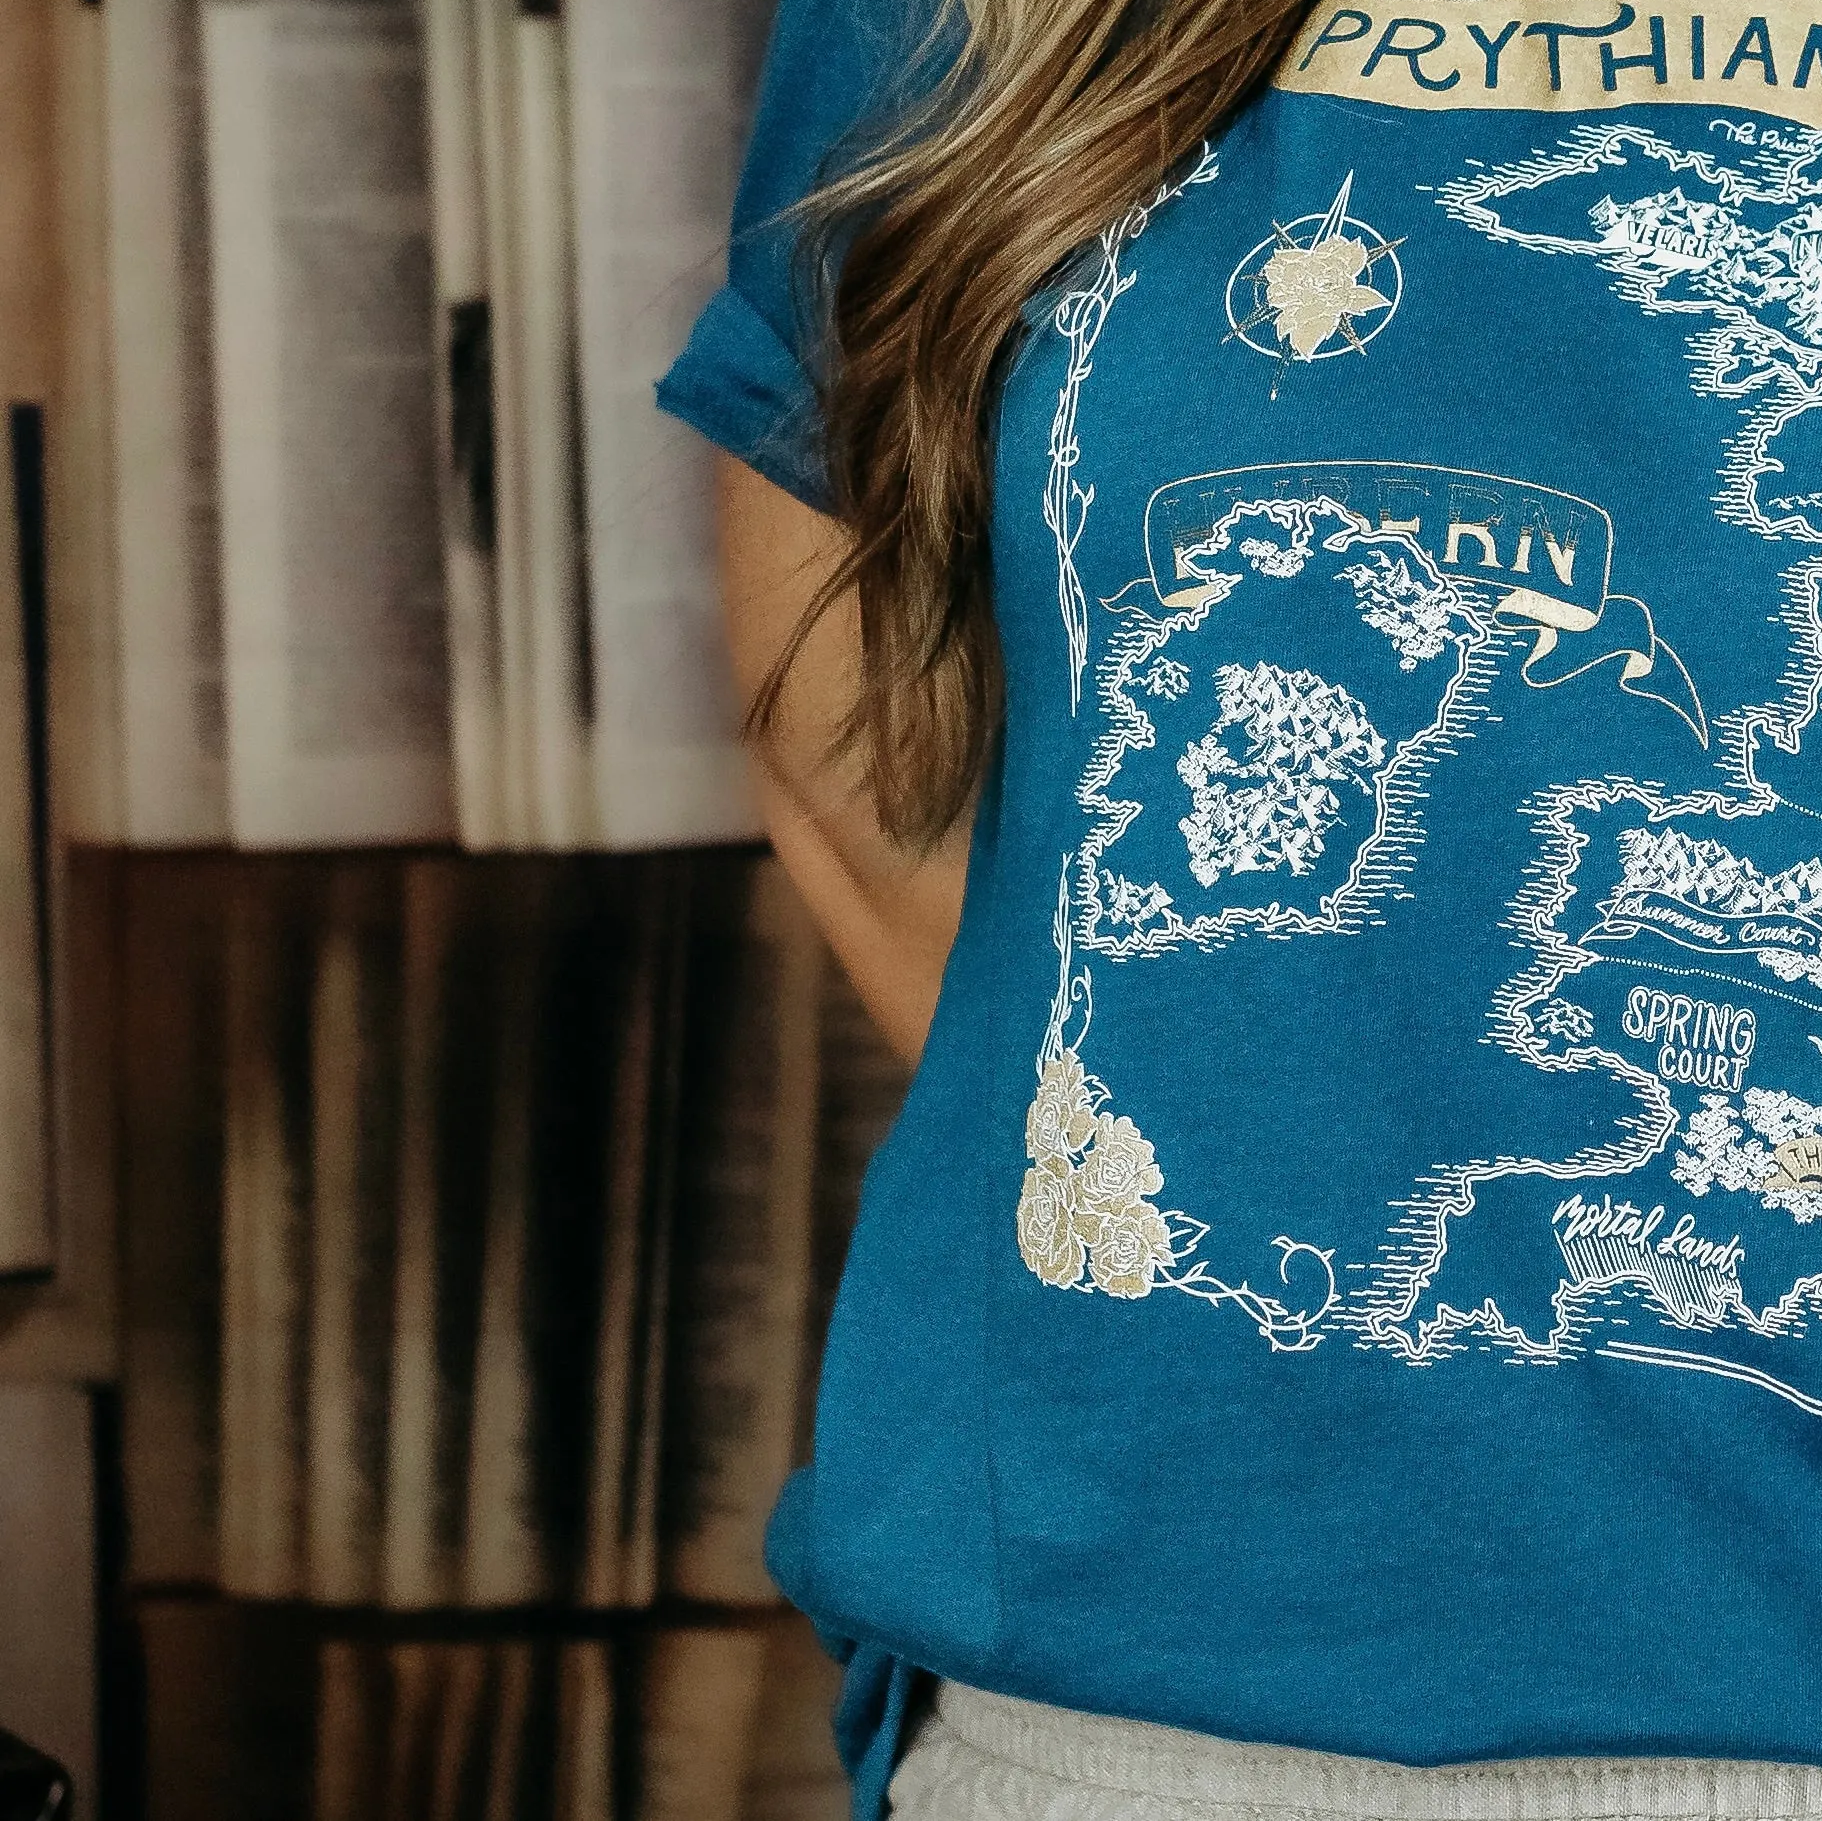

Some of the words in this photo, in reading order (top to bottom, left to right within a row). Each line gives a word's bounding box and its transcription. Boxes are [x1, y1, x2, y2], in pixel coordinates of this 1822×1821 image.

[1709, 119, 1757, 145] The
[1627, 221, 1719, 261] VELARIS
[1614, 893, 1730, 944] Summer
[1738, 921, 1816, 946] Court
[1622, 986, 1756, 1057] SPRING
[1658, 1044, 1749, 1093] COURT
[1551, 1193, 1665, 1254] Mortal
[1656, 1213, 1746, 1279] Lands
